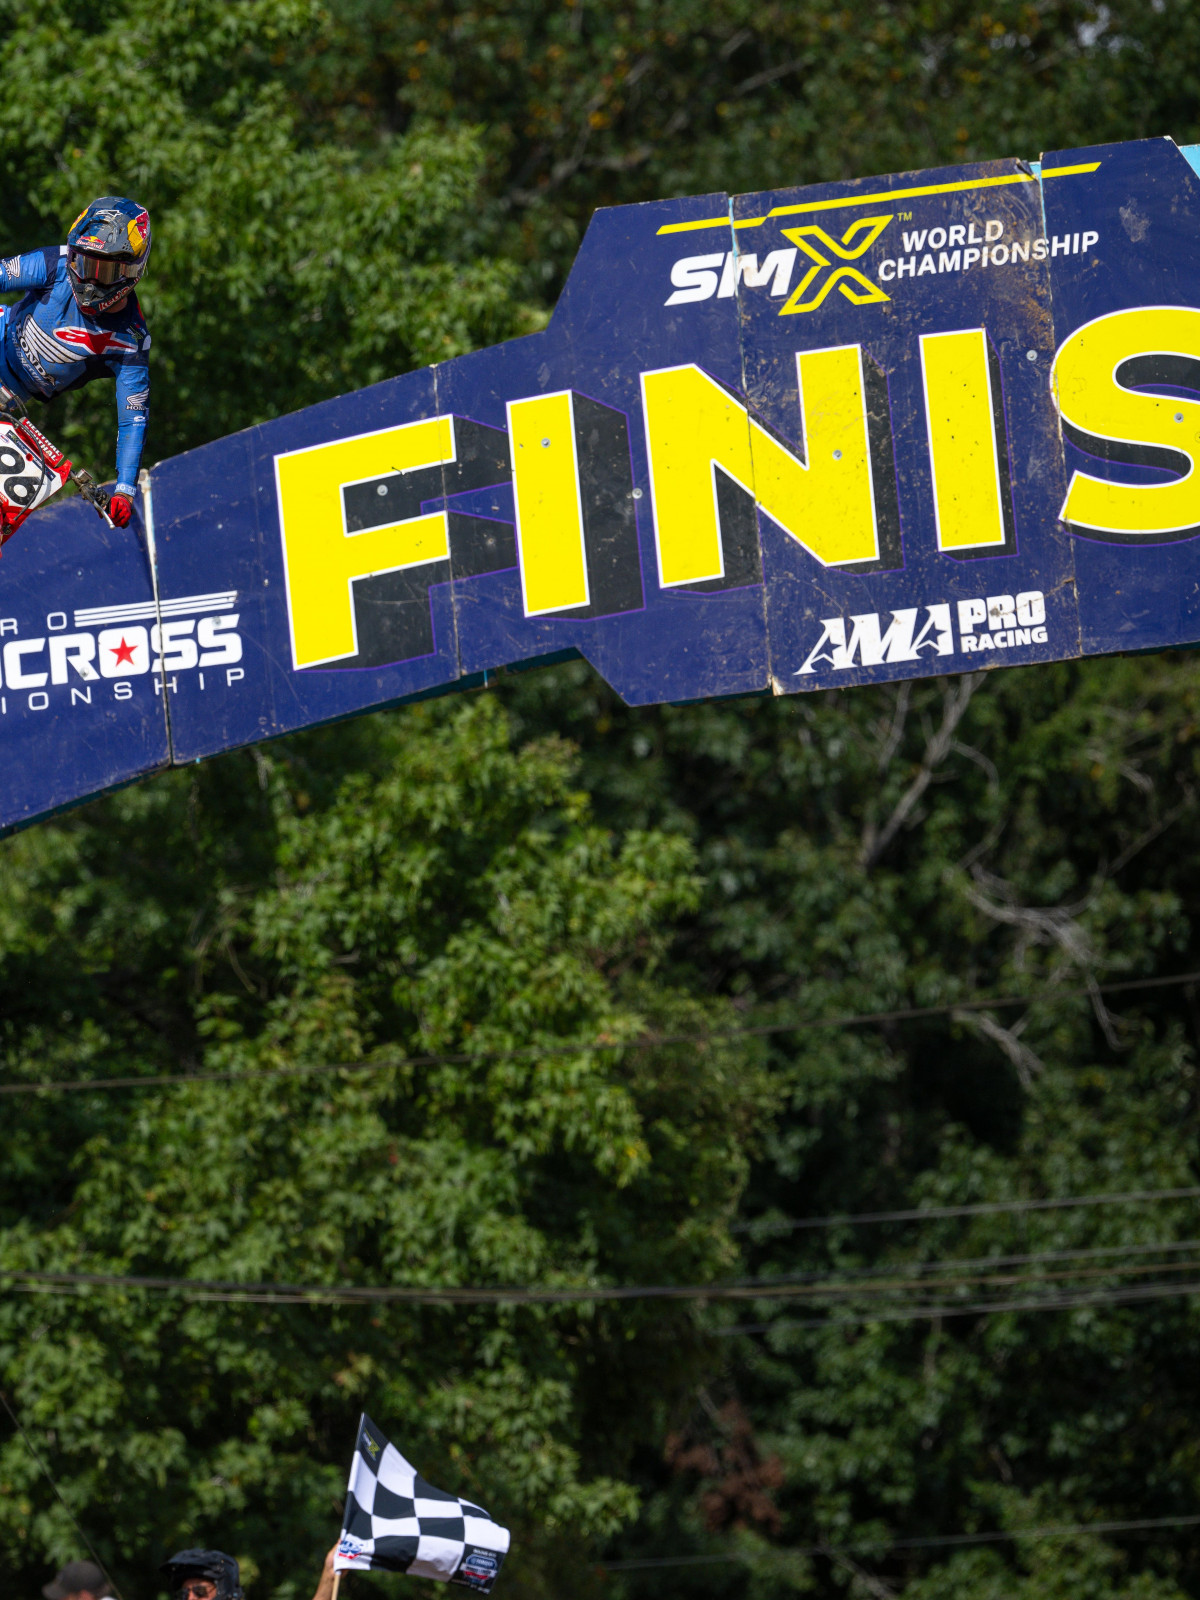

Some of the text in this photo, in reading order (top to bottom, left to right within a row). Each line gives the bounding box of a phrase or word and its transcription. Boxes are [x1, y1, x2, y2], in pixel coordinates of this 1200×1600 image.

[664, 214, 893, 316] SMX
[878, 231, 1099, 282] CHAMPIONSHIP
[902, 219, 1004, 253] WORLD
[16, 323, 55, 386] HONDA
[274, 305, 1200, 671] FINIS
[793, 590, 1046, 675] AMA PRO
[961, 626, 1049, 654] RACING
